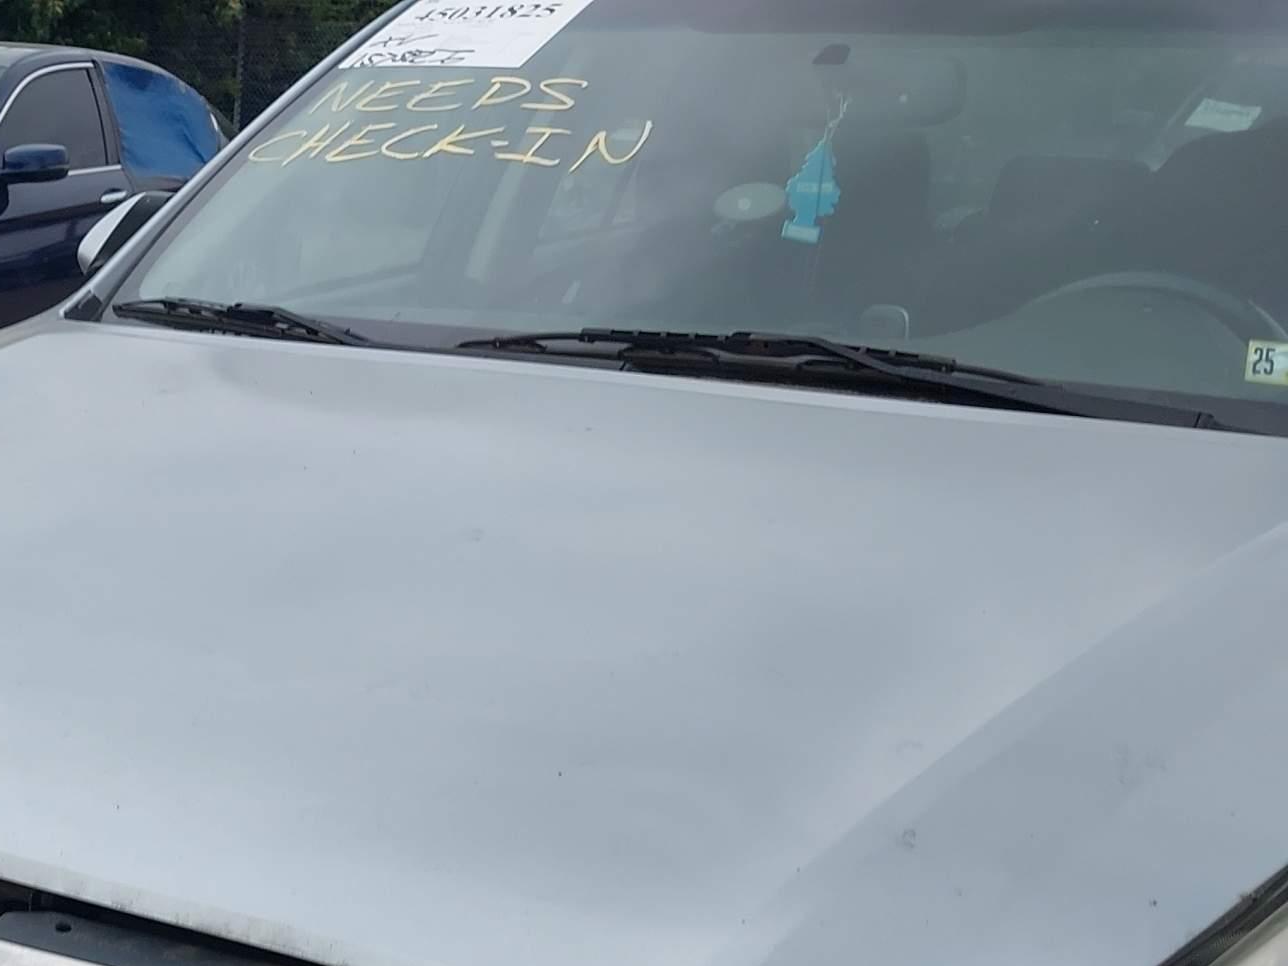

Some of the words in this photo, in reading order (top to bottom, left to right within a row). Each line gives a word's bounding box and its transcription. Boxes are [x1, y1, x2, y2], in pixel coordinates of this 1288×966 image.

[311, 76, 588, 114] NEEDS
[248, 120, 653, 174] CHECK-IN
[1252, 347, 1276, 375] 25
